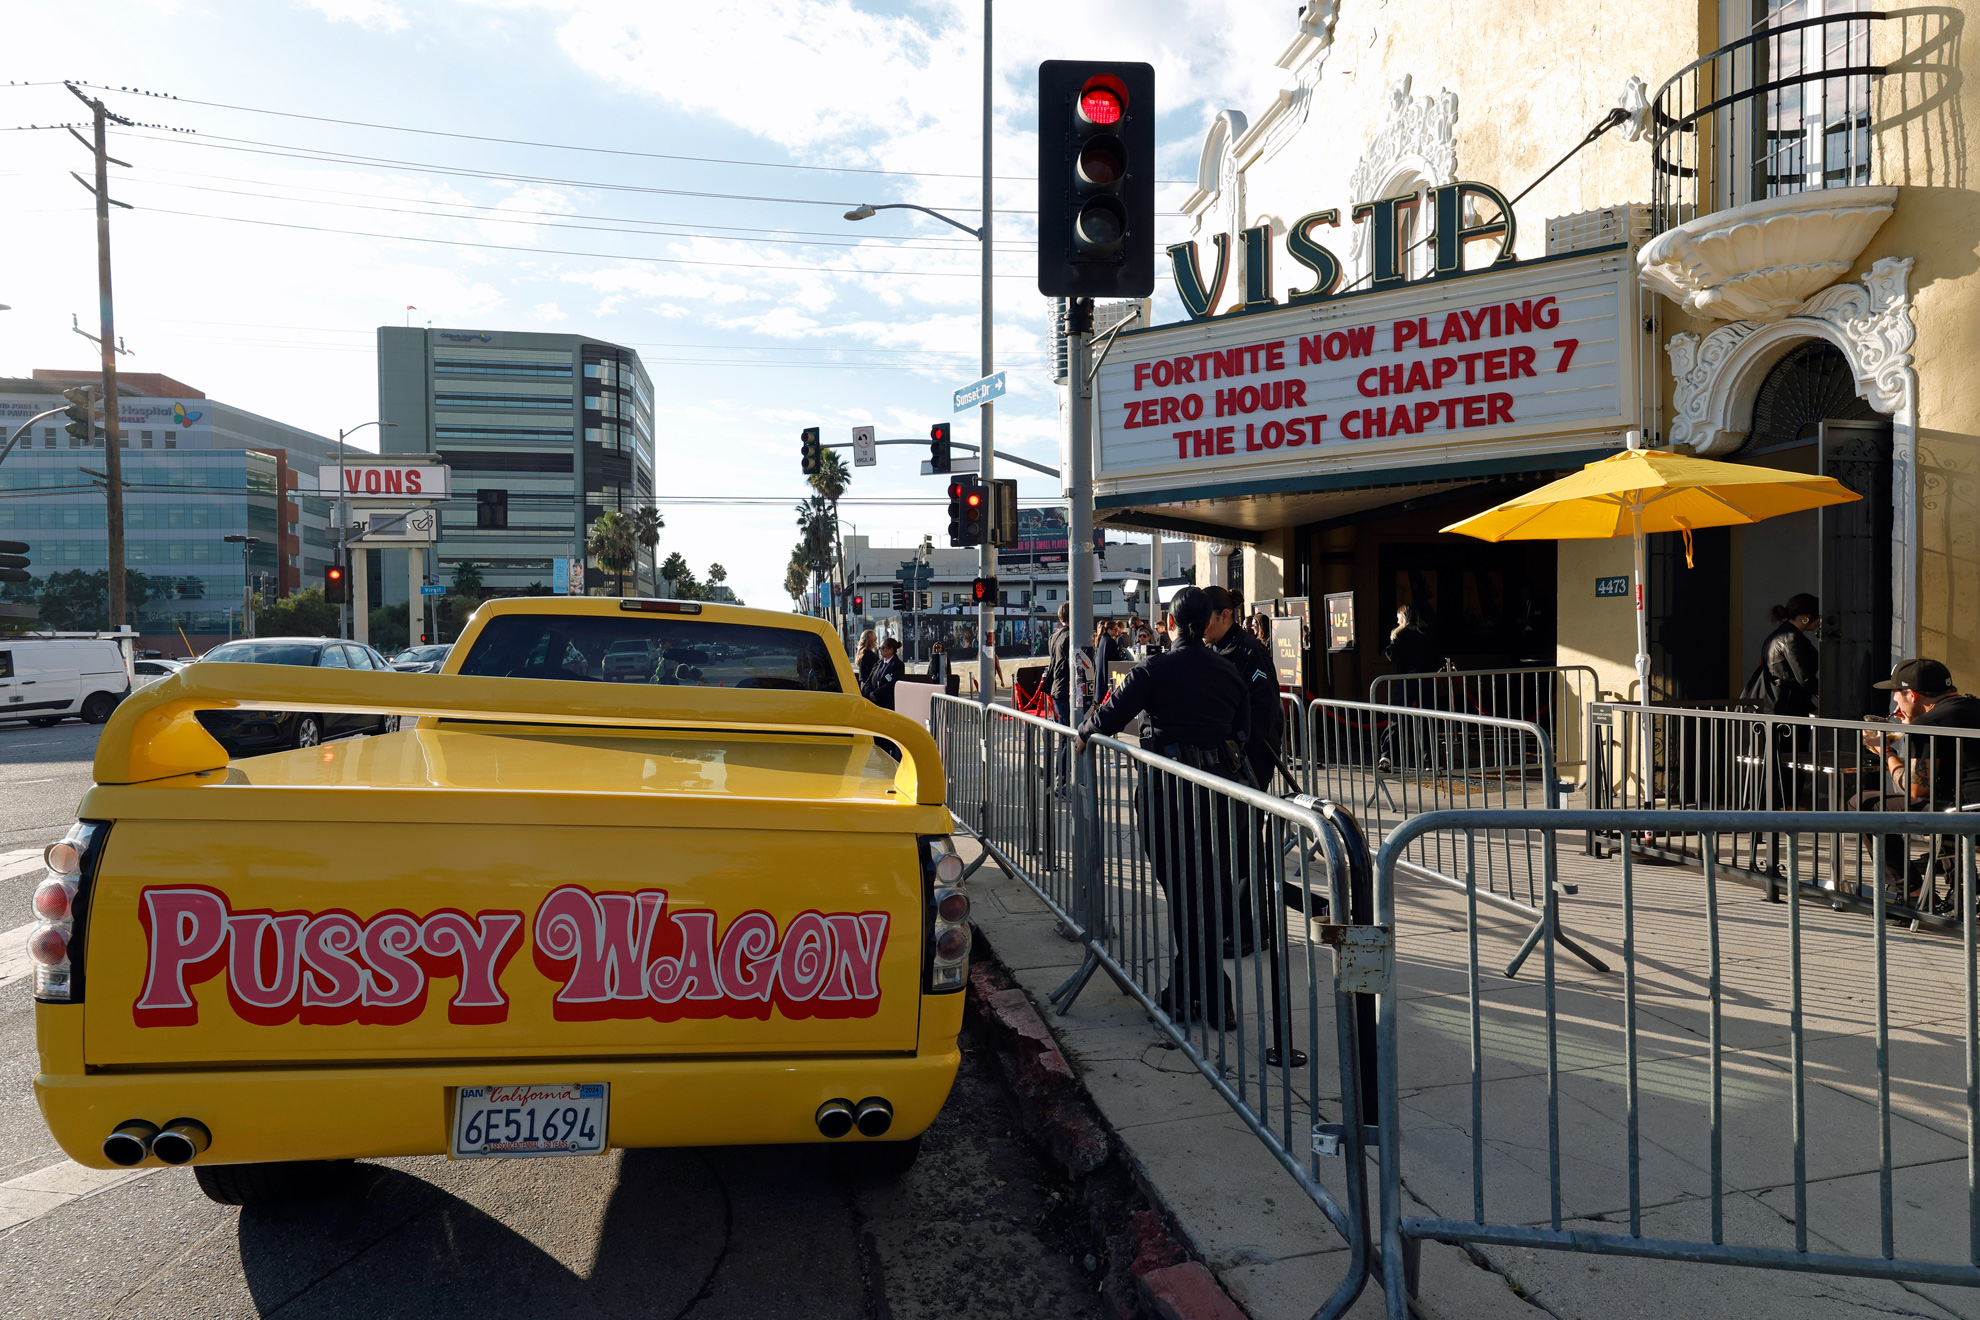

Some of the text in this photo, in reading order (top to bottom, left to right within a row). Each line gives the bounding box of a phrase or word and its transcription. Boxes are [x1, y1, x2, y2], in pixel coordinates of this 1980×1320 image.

[1167, 180, 1518, 320] VISTA
[1134, 296, 1560, 391] FORTNITE NOW PLAYING
[956, 384, 991, 407] Sunset Dr
[1123, 339, 1578, 430] ZERO HOUR CHAPTER 7
[121, 405, 172, 419] Hospital
[1173, 391, 1515, 459] THE LOST CHAPTER
[344, 469, 422, 495] VONS
[1598, 578, 1626, 594] 4473
[1334, 612, 1348, 628] U-Z
[1277, 637, 1292, 647] WILL
[1280, 649, 1296, 658] CALL
[133, 884, 890, 1028] PUSSY WAGON
[462, 1088, 484, 1099] JAN
[490, 1086, 582, 1107] California
[465, 1107, 596, 1145] 6E51694
[492, 1141, 540, 1150] SESQUICENTENNIAL
[551, 1141, 569, 1149] YEARS
